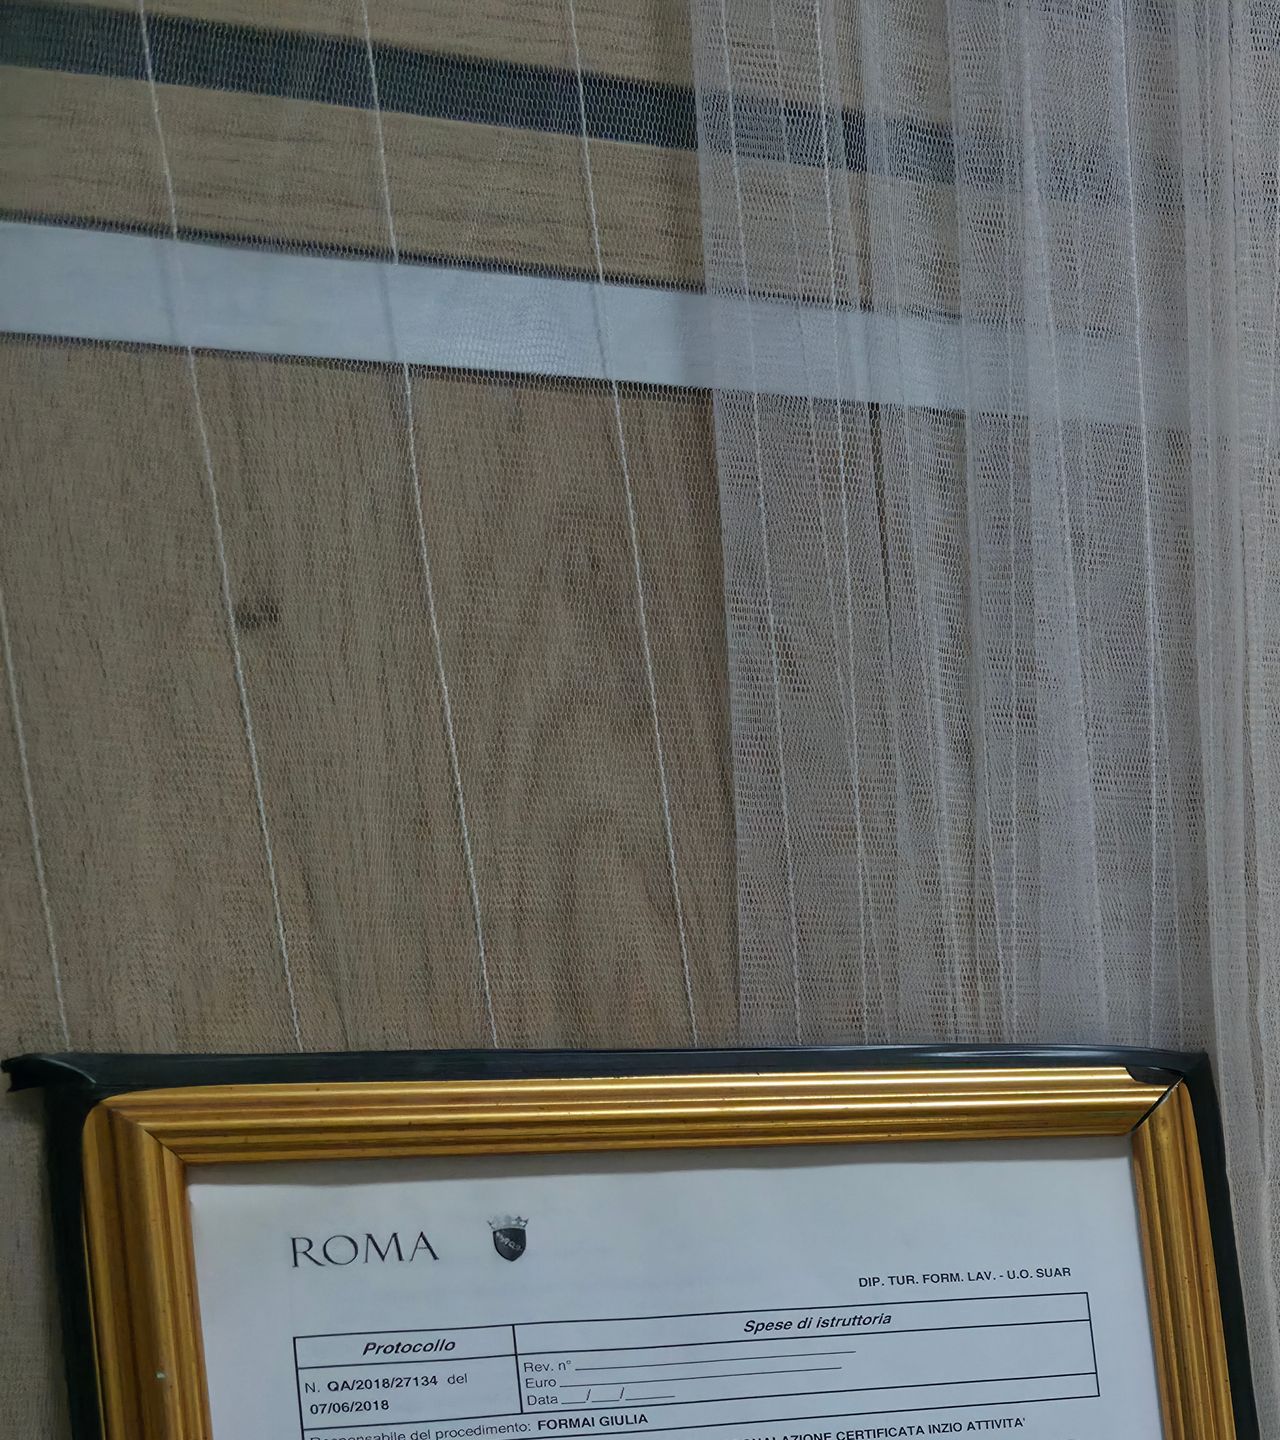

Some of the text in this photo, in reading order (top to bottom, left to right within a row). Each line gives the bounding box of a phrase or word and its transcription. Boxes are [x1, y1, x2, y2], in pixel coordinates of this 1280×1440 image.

[290, 1231, 440, 1268] ROMA
[858, 1266, 1071, 1288] DIP. TUR. FORM. LAV. U.O. SUAR
[743, 1312, 892, 1336] Spese di istruttoria
[362, 1338, 456, 1356] Protocollo
[523, 1360, 572, 1373] Rev. n°
[304, 1373, 468, 1394] N. QA/2018/27134 del
[524, 1377, 557, 1389] Euro
[309, 1399, 390, 1415] 07/06/2018
[526, 1394, 559, 1406] Data
[537, 1416, 596, 1431] FORMAI
[598, 1413, 649, 1427] GIULIA
[927, 1422, 963, 1435] INZIO
[966, 1417, 1026, 1432] ATTIVITA'
